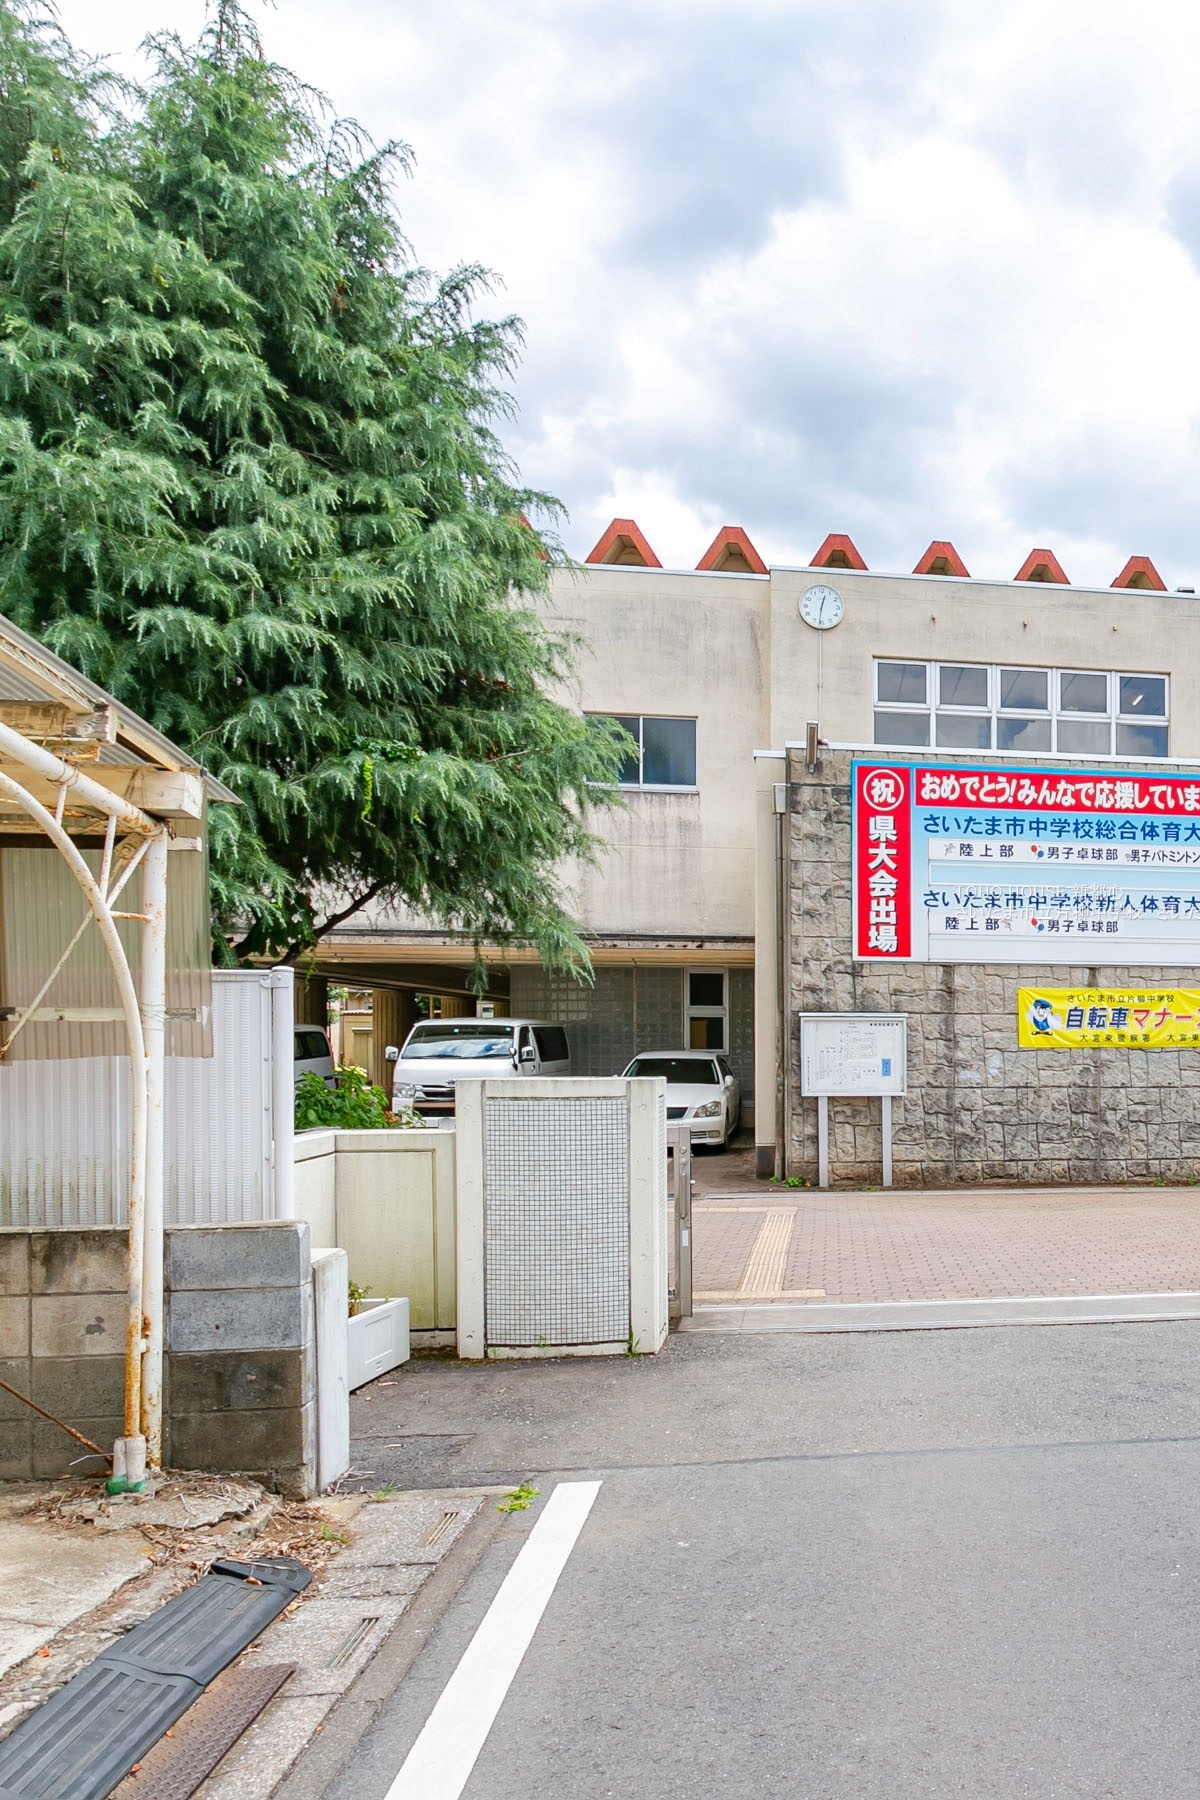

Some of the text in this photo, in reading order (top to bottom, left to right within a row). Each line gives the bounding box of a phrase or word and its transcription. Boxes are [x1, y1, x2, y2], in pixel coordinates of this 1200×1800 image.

[959, 843, 1015, 858] 陸上部
[1047, 846, 1118, 861] 男子卓球部
[868, 815, 898, 953] 県大会出場
[945, 916, 1000, 931] 陸上部
[1048, 919, 1119, 933] 男子卓球部
